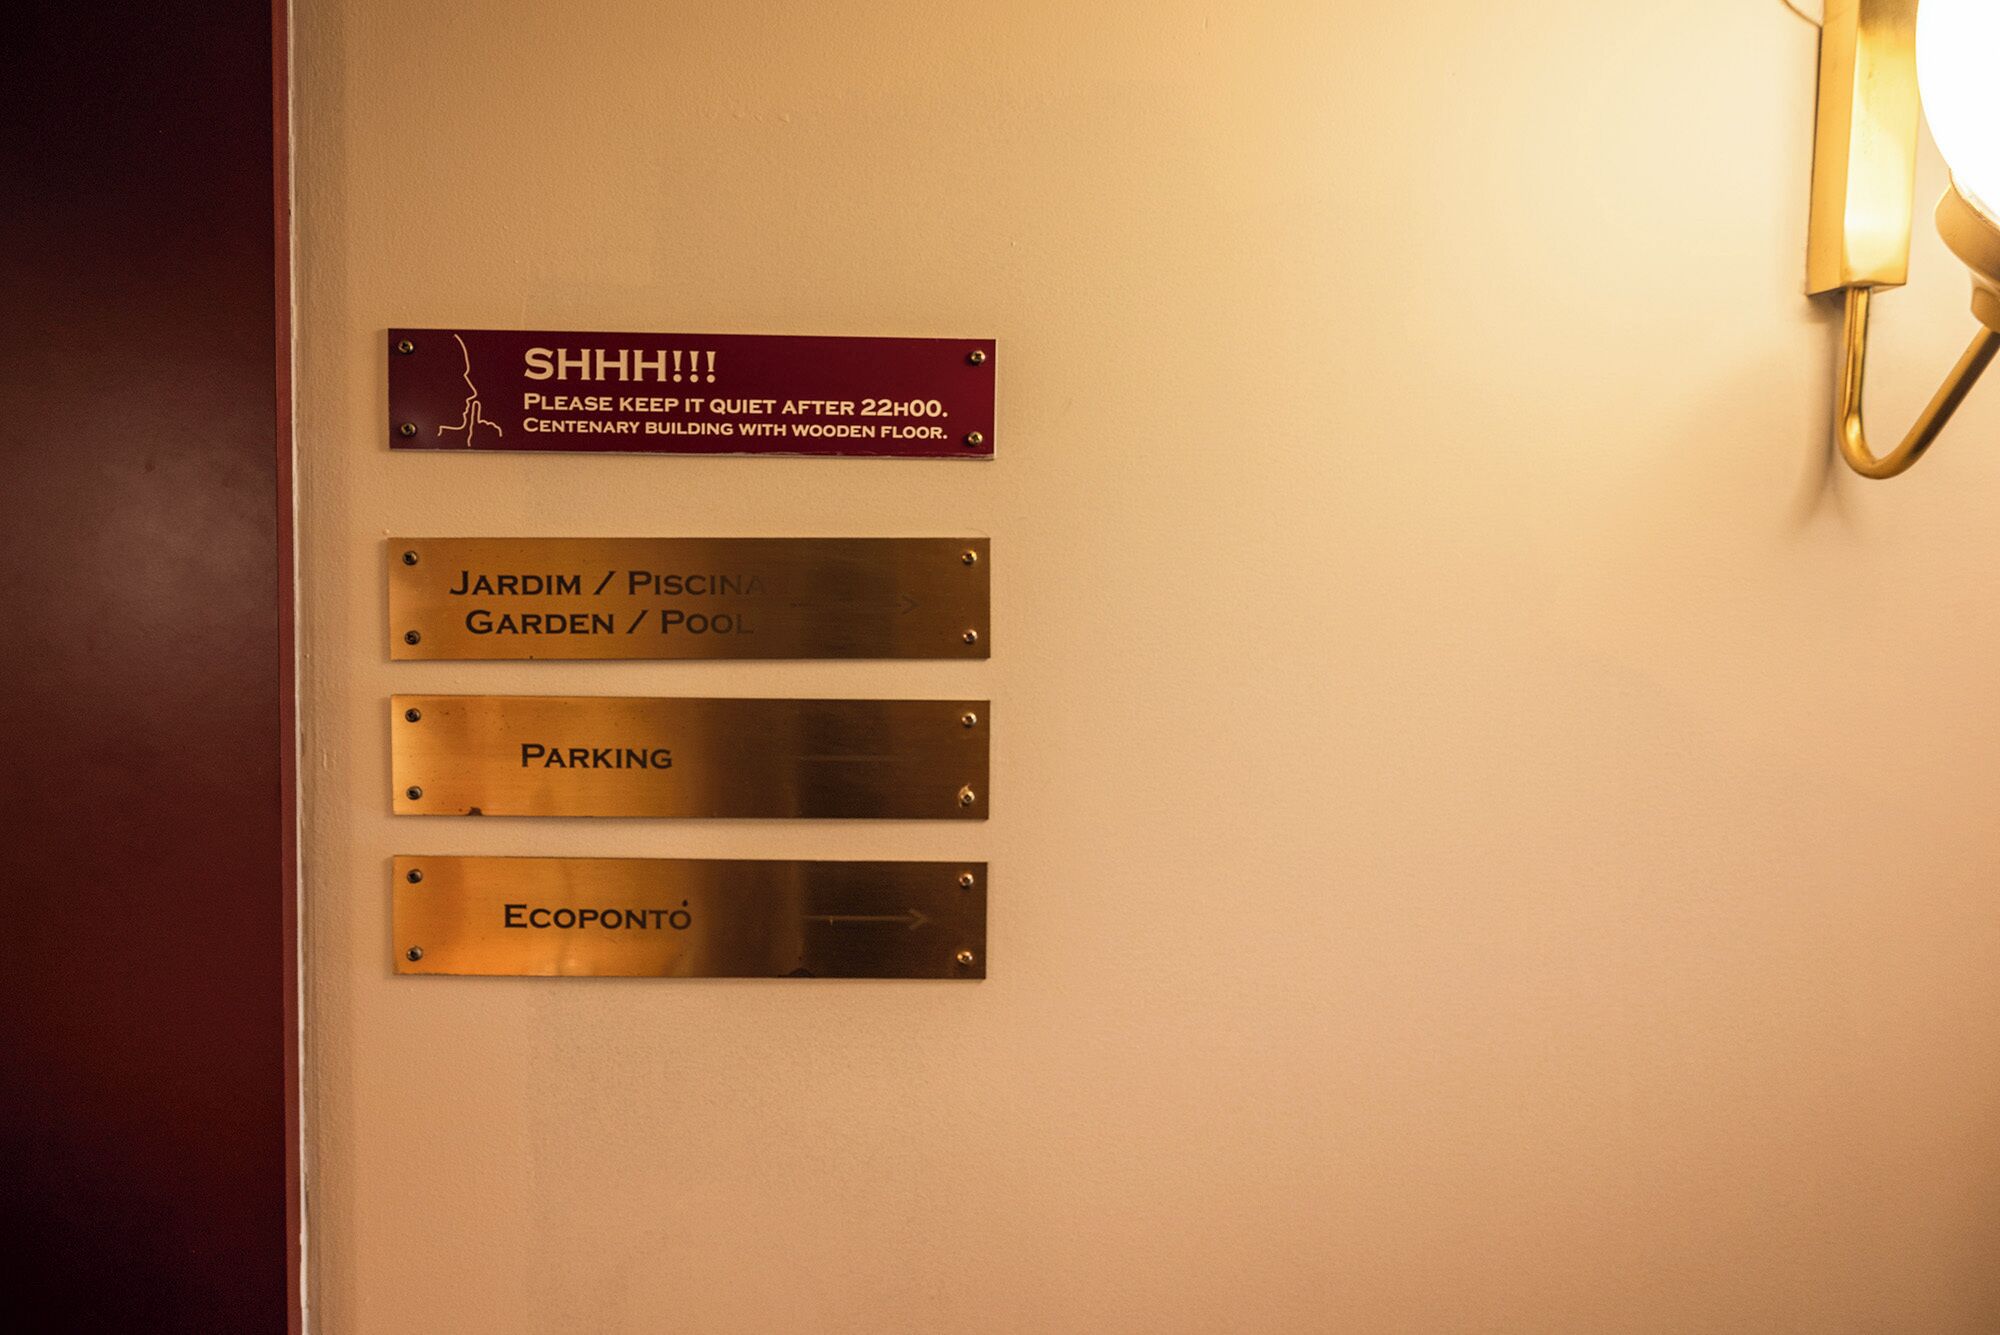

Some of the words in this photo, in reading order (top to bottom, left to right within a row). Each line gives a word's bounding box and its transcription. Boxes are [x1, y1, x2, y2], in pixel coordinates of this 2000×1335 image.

[524, 347, 717, 383] SHHH!!!
[523, 392, 613, 412] PLEASE
[619, 397, 679, 412] KEEP
[685, 398, 705, 413] IT
[709, 399, 777, 415] QUIET
[781, 400, 855, 416] AFTER
[523, 417, 640, 434] CENTENARY
[645, 421, 734, 436] BUILDING
[738, 423, 787, 437] WITH
[791, 424, 876, 438] WOODEN
[880, 425, 948, 440] FLOOR.
[449, 570, 582, 596] JARDIM
[593, 570, 617, 596] /
[628, 570, 768, 596] PISCINA
[465, 609, 615, 635] GARDEN
[625, 609, 649, 635] /
[661, 609, 755, 635] POOL
[521, 743, 673, 770] PARKING
